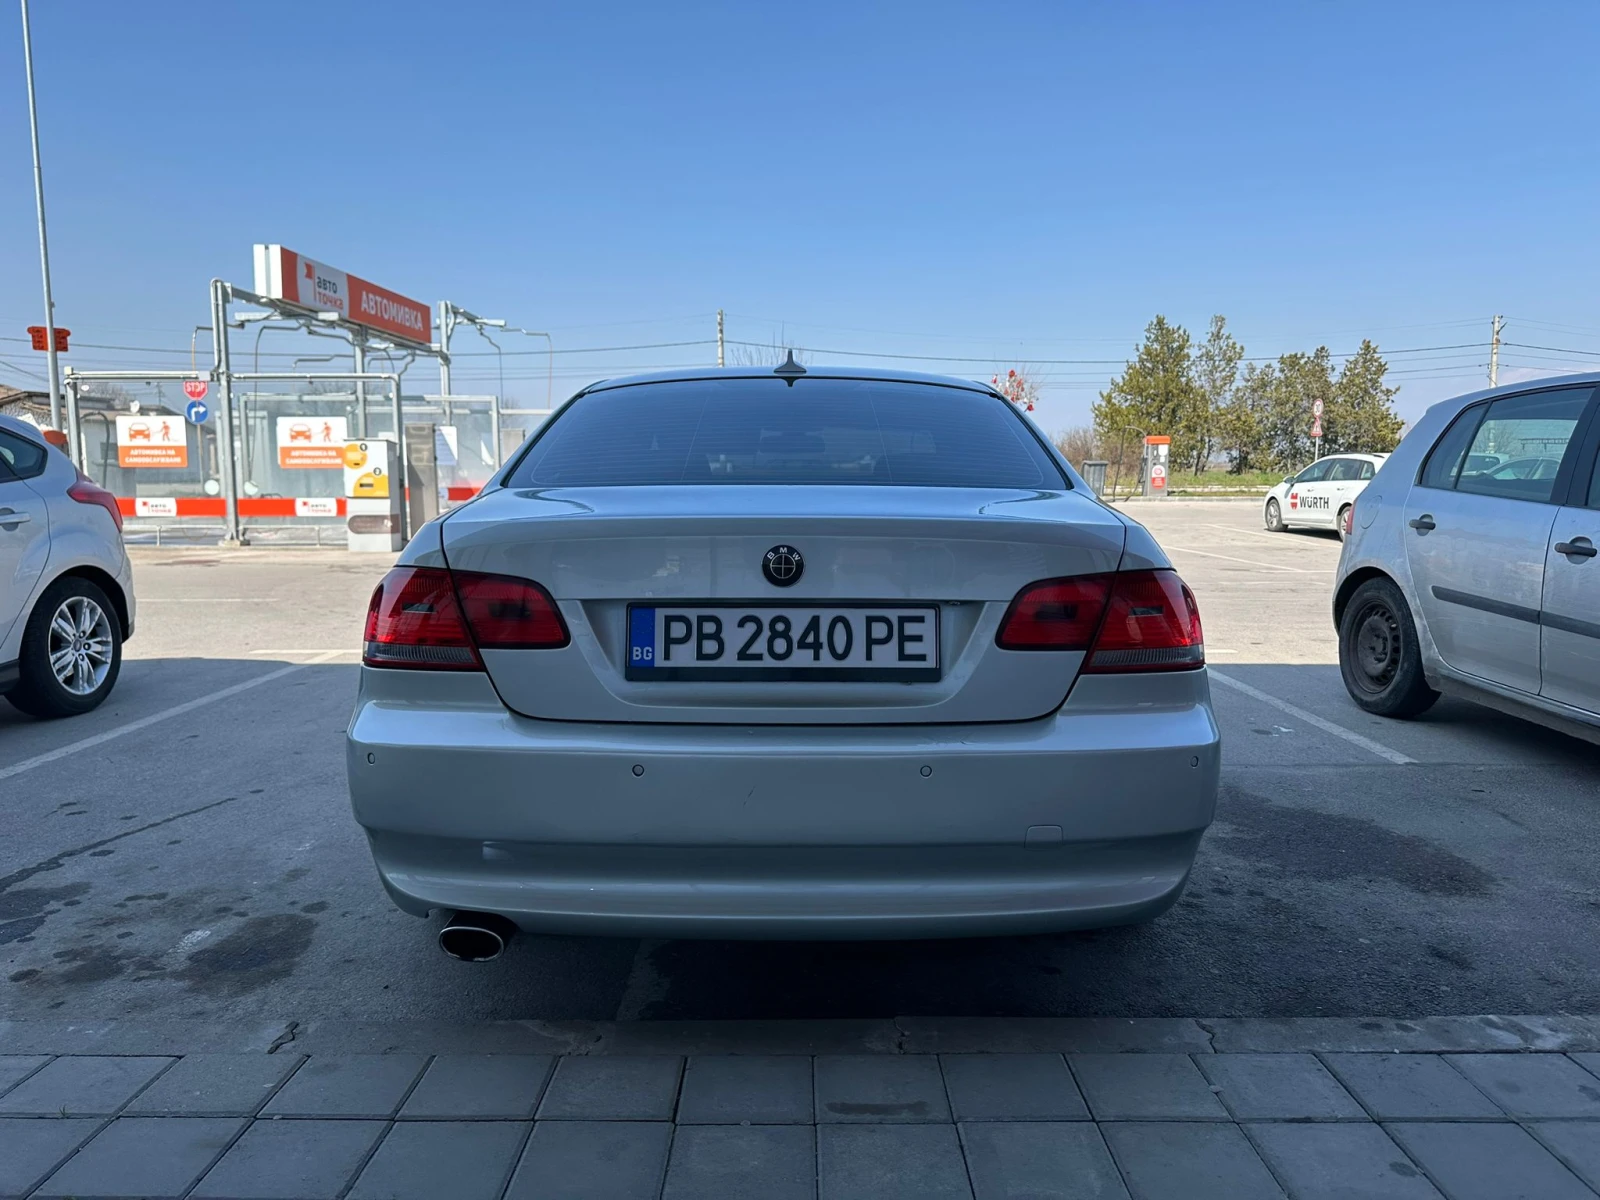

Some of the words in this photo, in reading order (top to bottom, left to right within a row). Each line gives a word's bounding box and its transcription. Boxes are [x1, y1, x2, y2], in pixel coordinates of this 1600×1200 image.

[317, 276, 338, 294] авто
[361, 290, 424, 331] АВТОМИВКА
[186, 381, 206, 393] STOP
[1299, 496, 1330, 509] WÜRTH
[767, 547, 800, 560] BMW
[663, 614, 725, 662] PB
[736, 614, 854, 662] 2840
[865, 614, 927, 662] PE
[632, 646, 653, 660] BG
